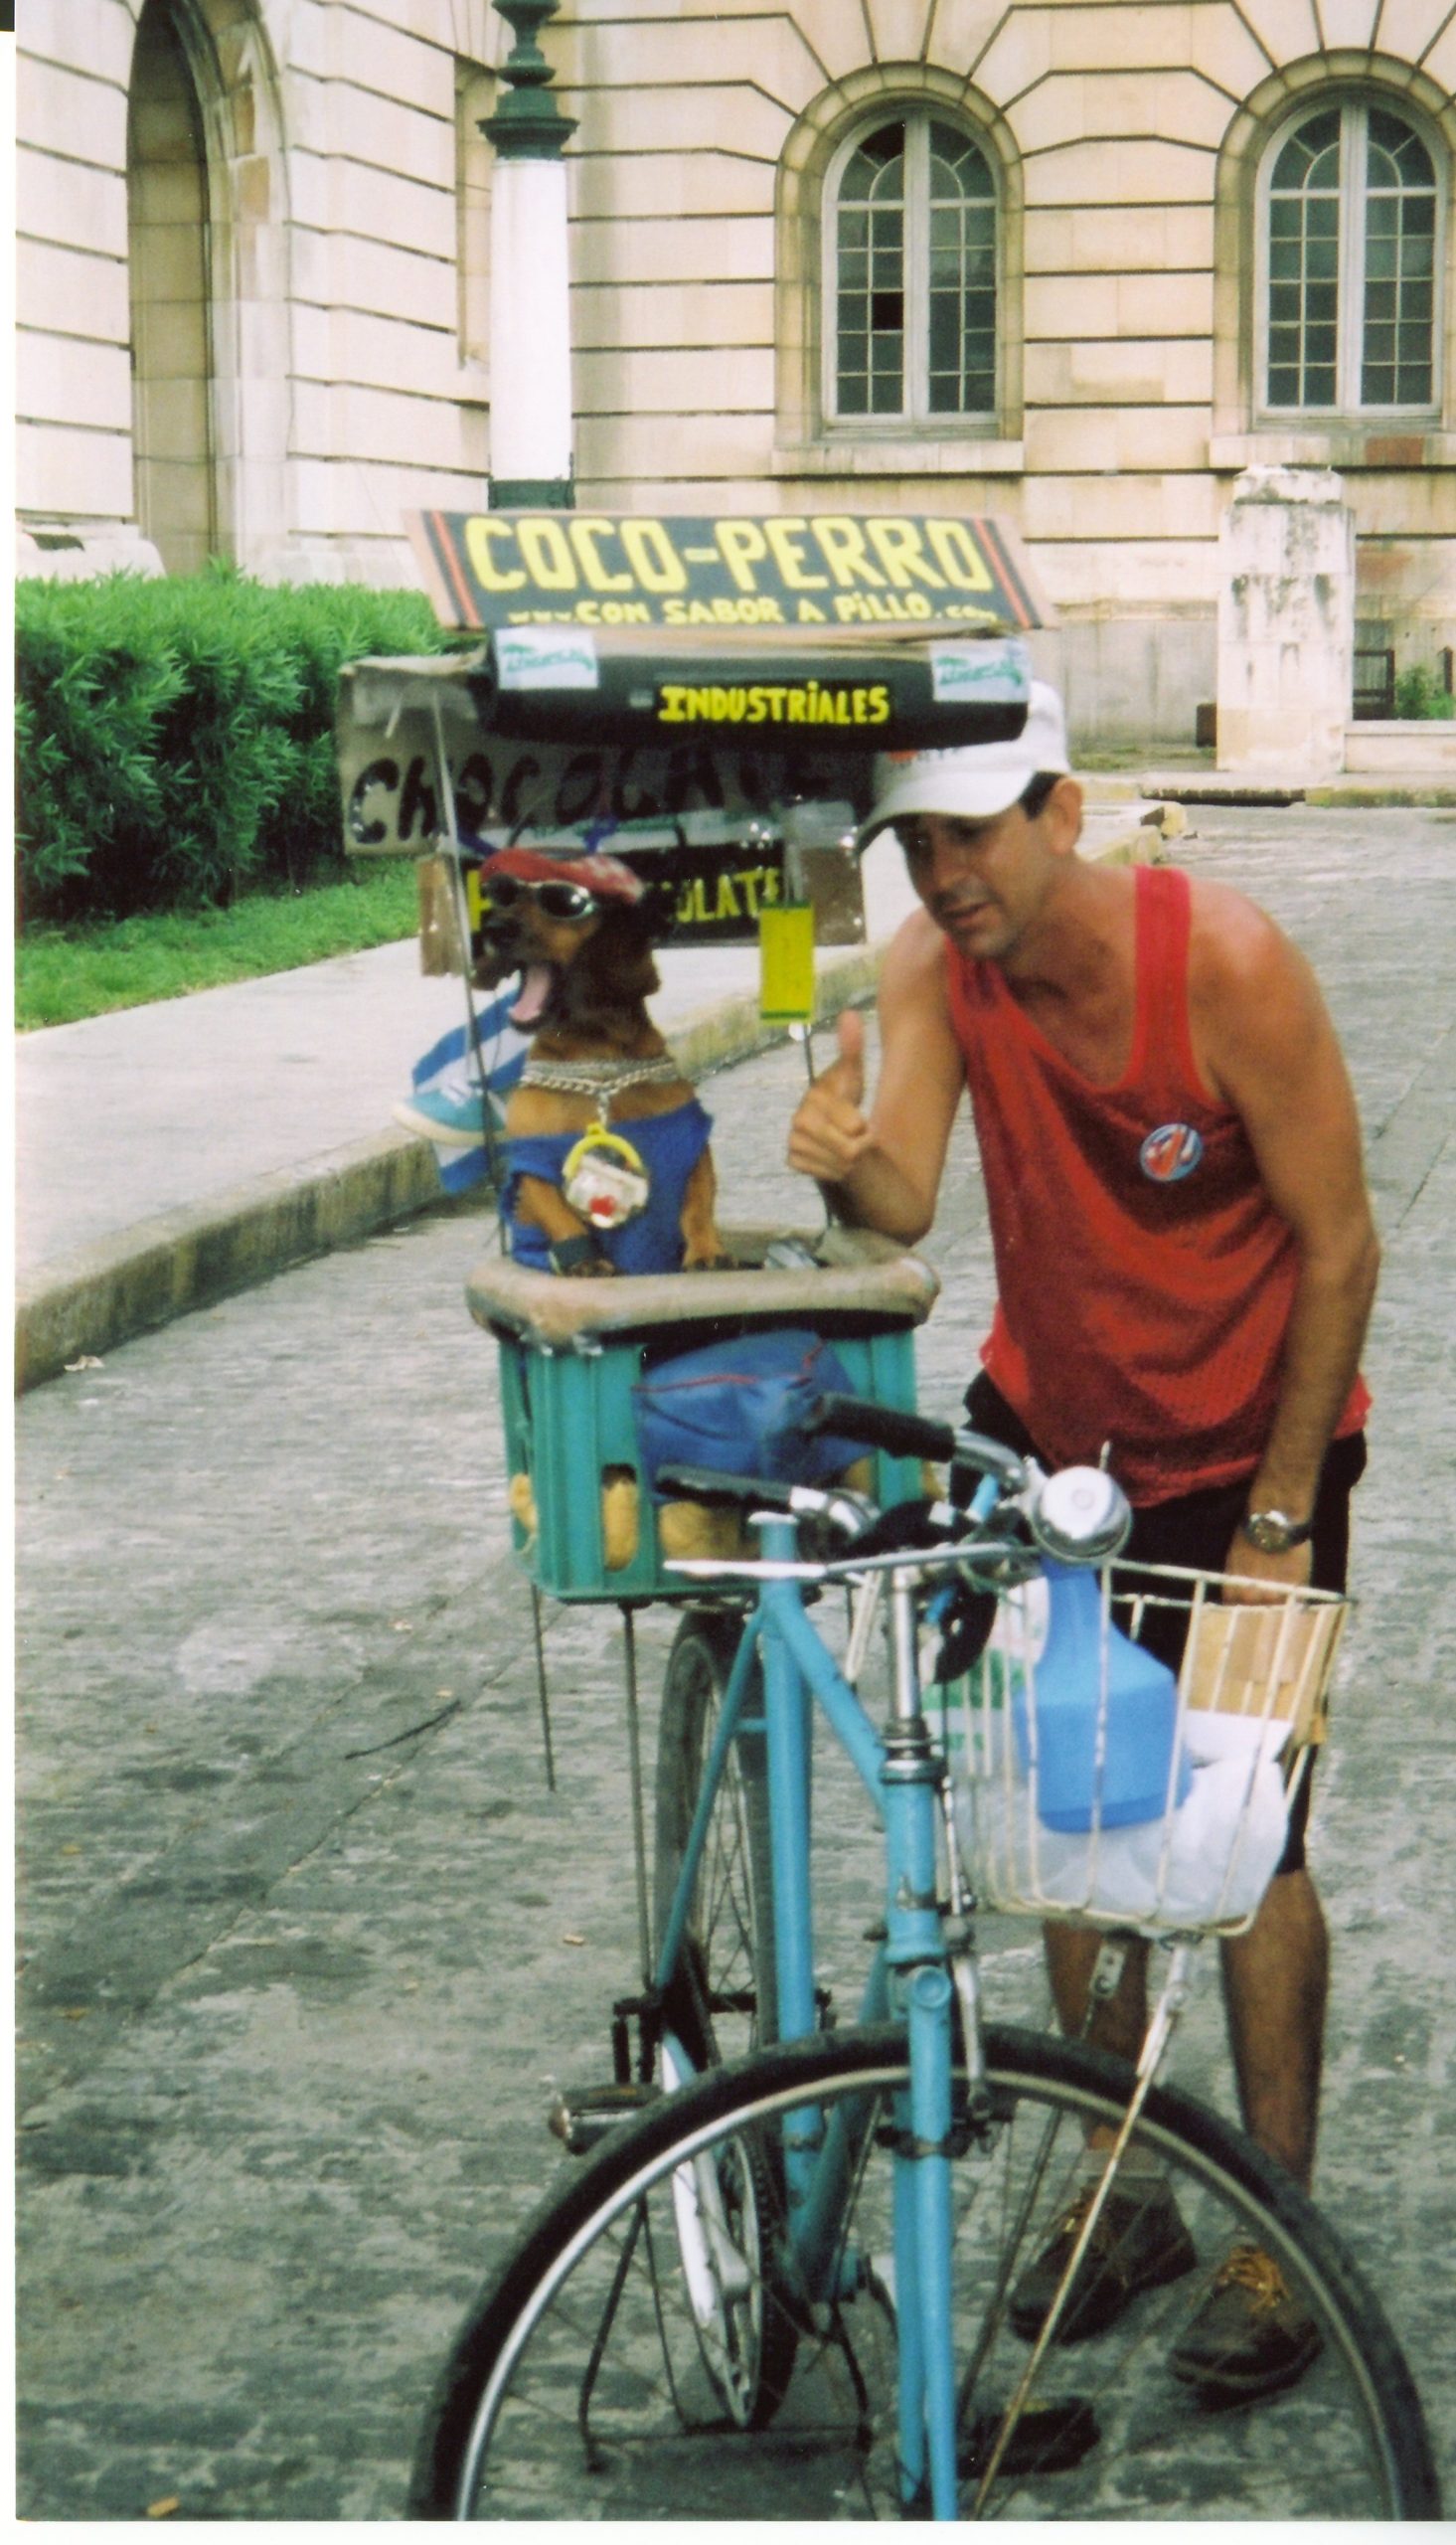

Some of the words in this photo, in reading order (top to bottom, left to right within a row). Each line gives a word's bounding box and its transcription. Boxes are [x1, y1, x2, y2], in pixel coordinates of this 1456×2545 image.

[464, 517, 993, 593] COCO-PERRO
[662, 597, 786, 624] SABOR
[798, 597, 827, 622] A
